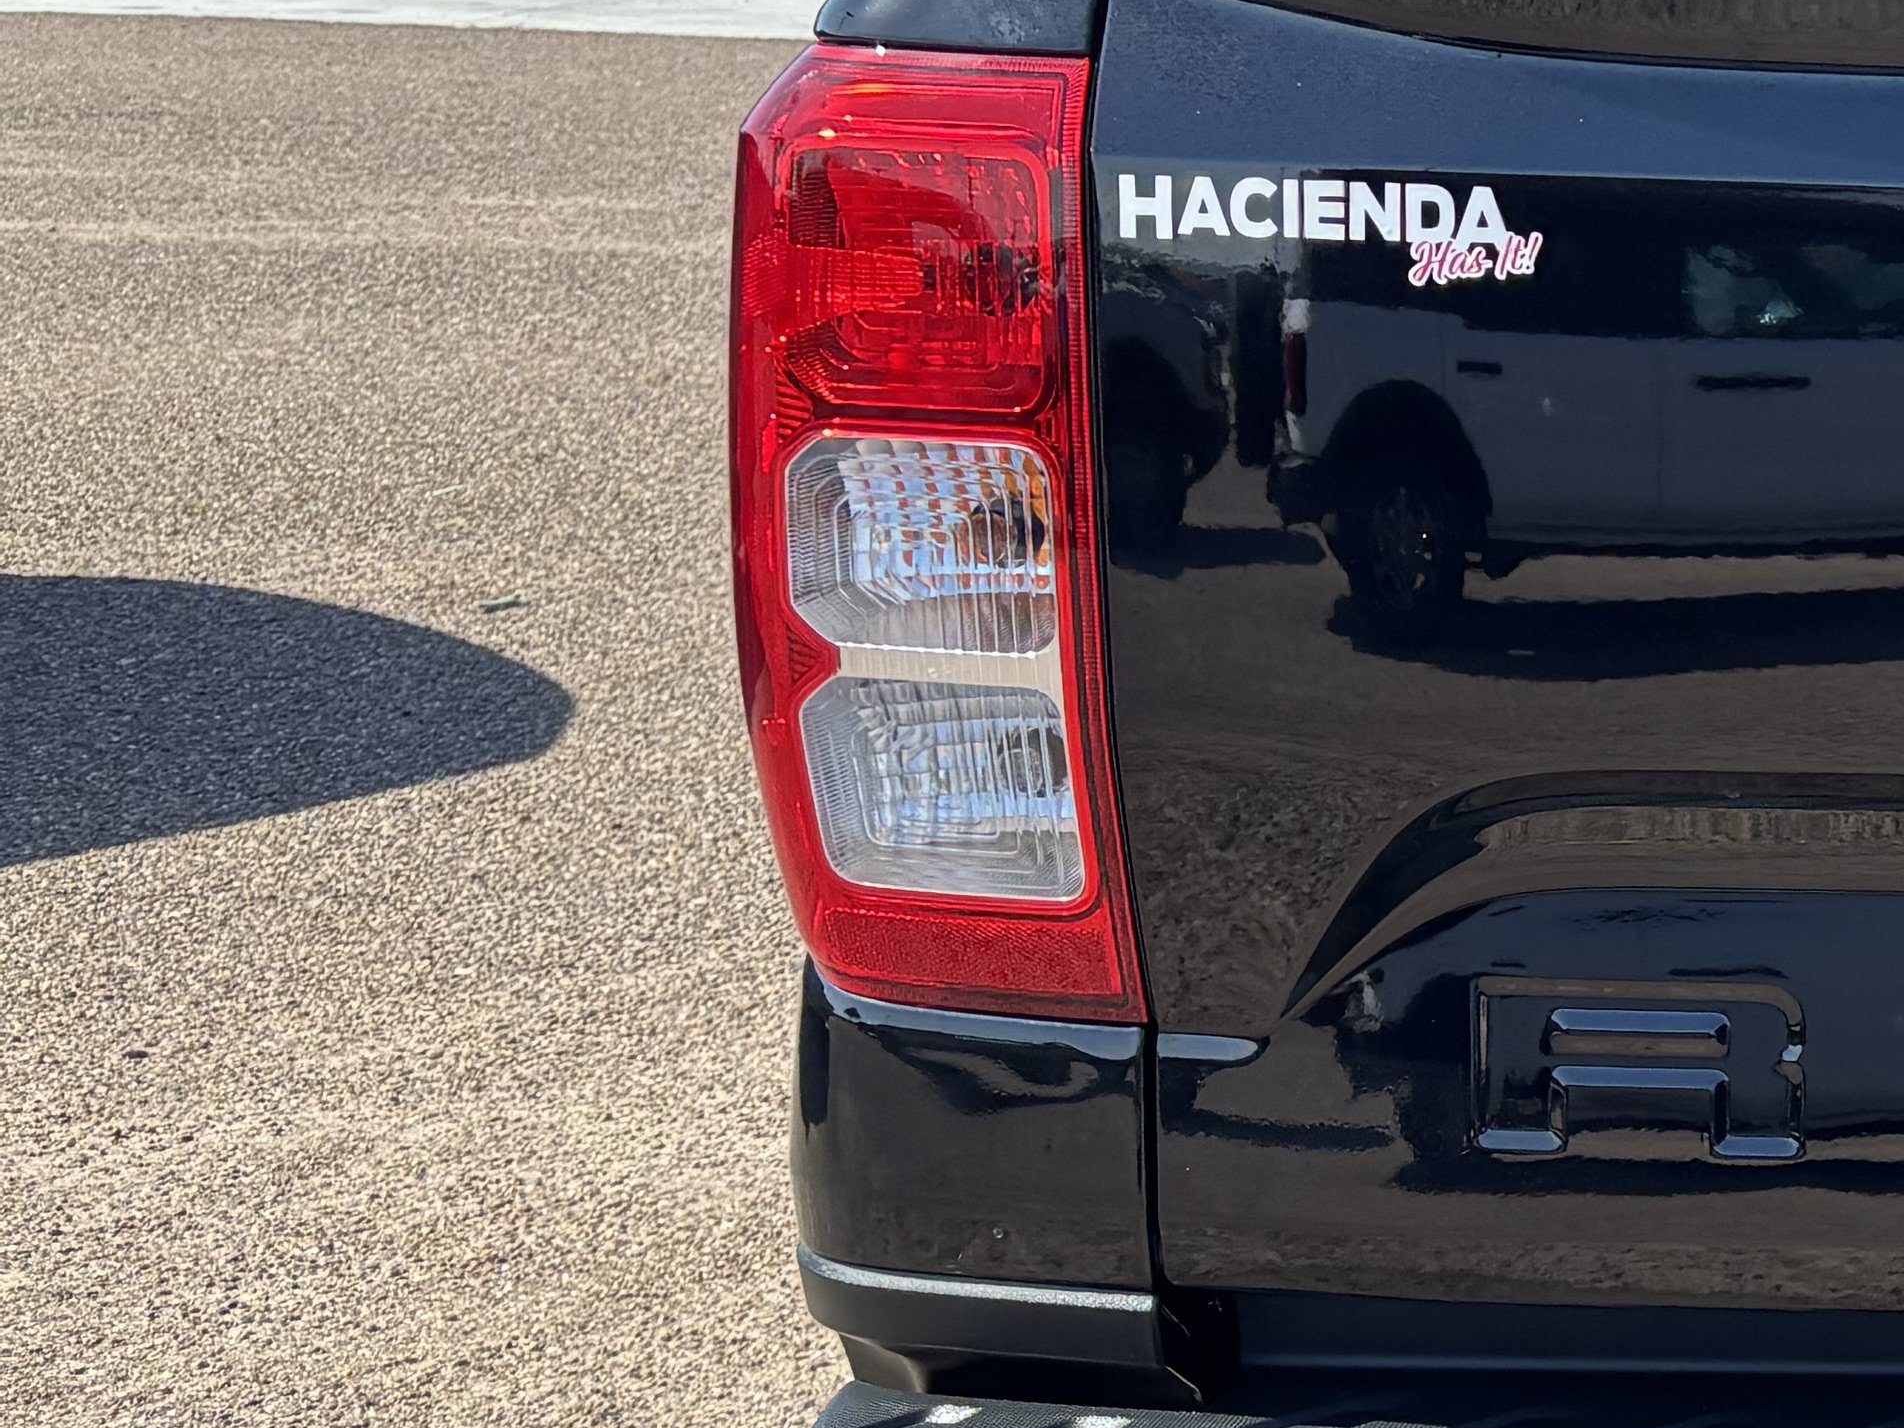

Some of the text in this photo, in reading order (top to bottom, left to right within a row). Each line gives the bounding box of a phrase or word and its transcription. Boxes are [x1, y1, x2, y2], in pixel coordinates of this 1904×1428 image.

[1117, 173, 1508, 249] HACIENDA
[1407, 231, 1544, 288] Has It!
